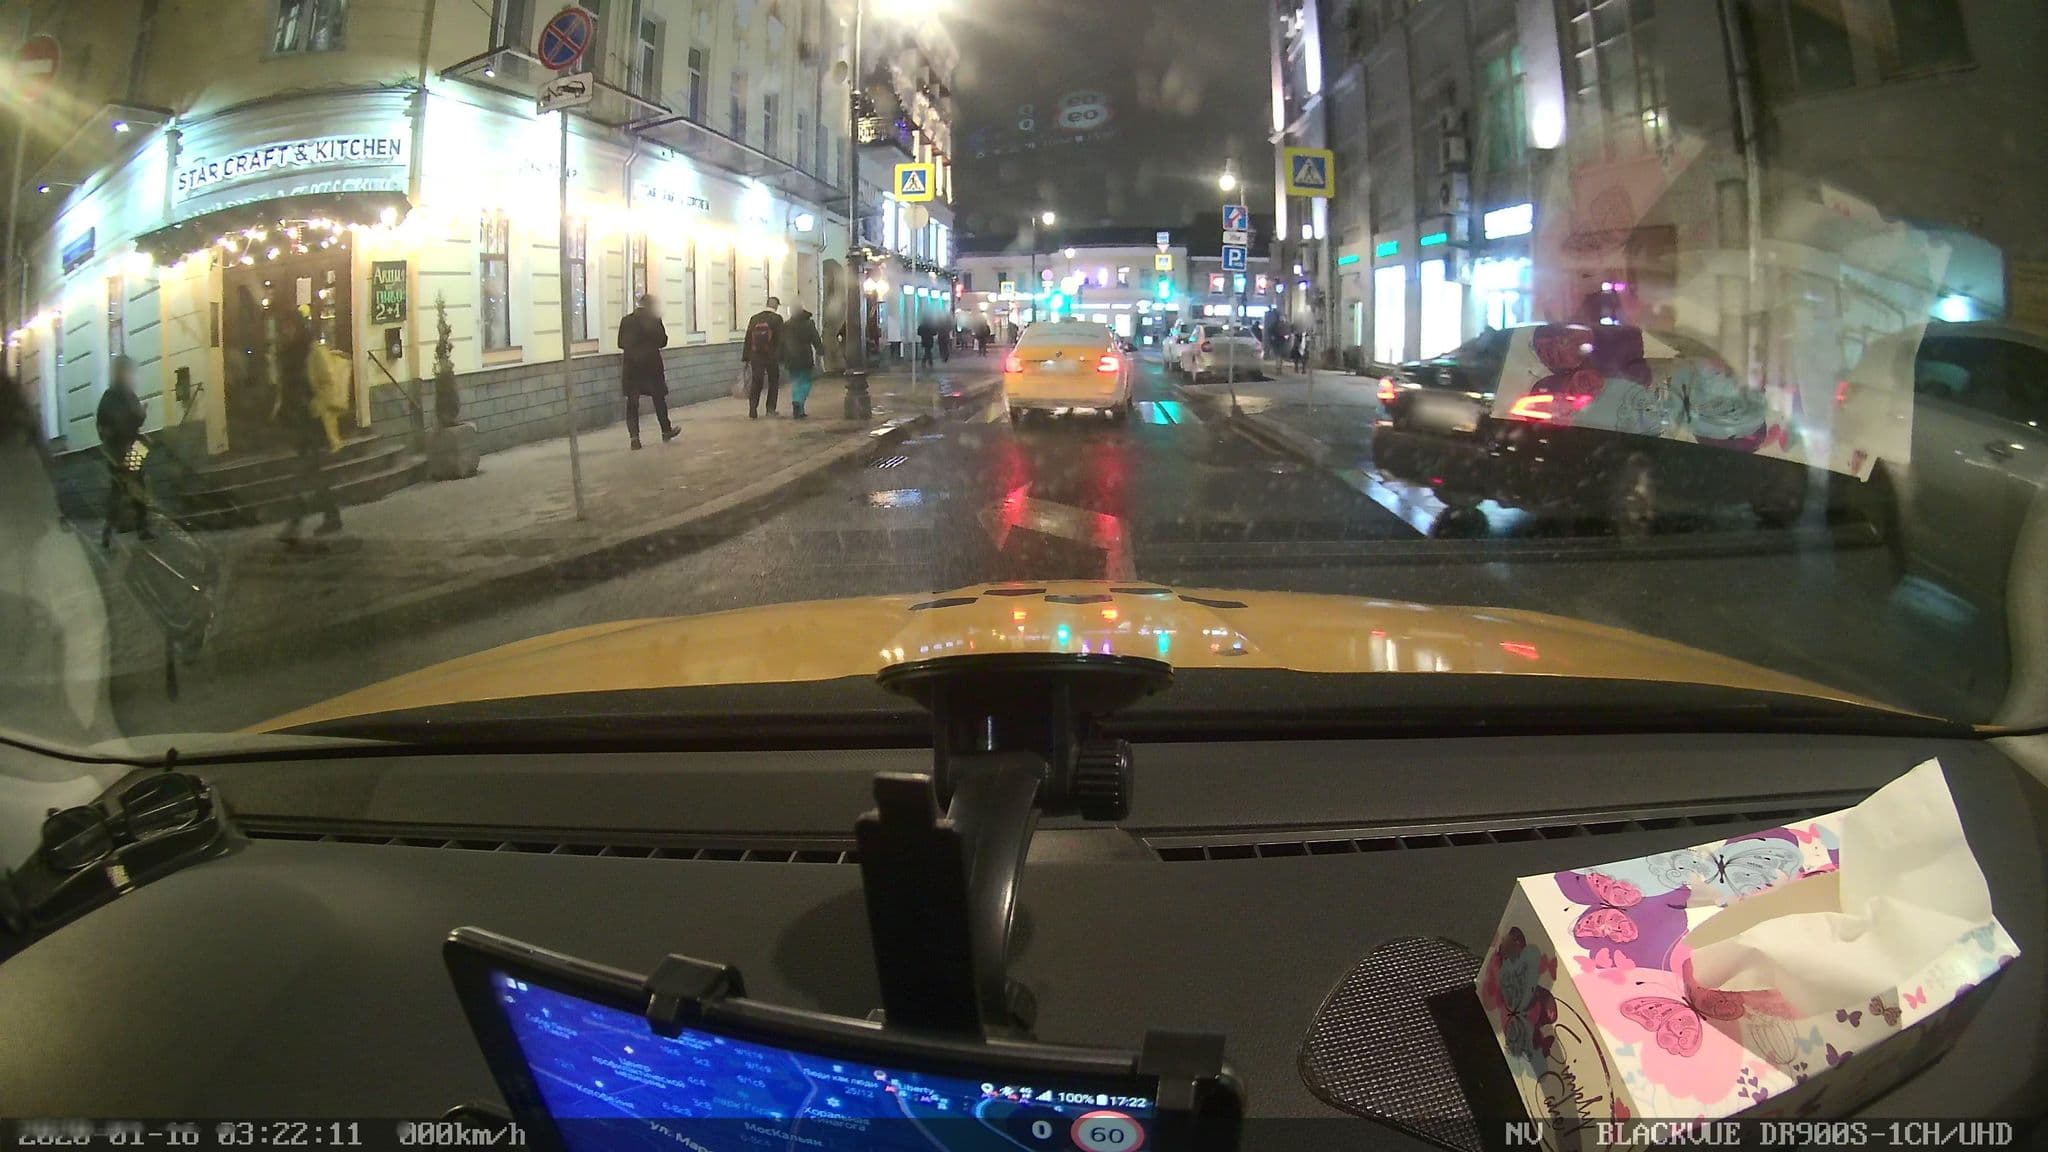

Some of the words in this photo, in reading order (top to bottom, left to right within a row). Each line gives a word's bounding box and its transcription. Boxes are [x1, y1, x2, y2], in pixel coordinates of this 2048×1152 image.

[178, 161, 219, 190] STAR
[224, 144, 288, 176] CRAFT
[295, 142, 308, 162] &
[315, 138, 401, 159] KITCHEN
[375, 303, 401, 320] 2+1
[1058, 1092, 1095, 1105] 100%
[1110, 1096, 1147, 1109] 17:22
[1090, 1127, 1125, 1144] 60
